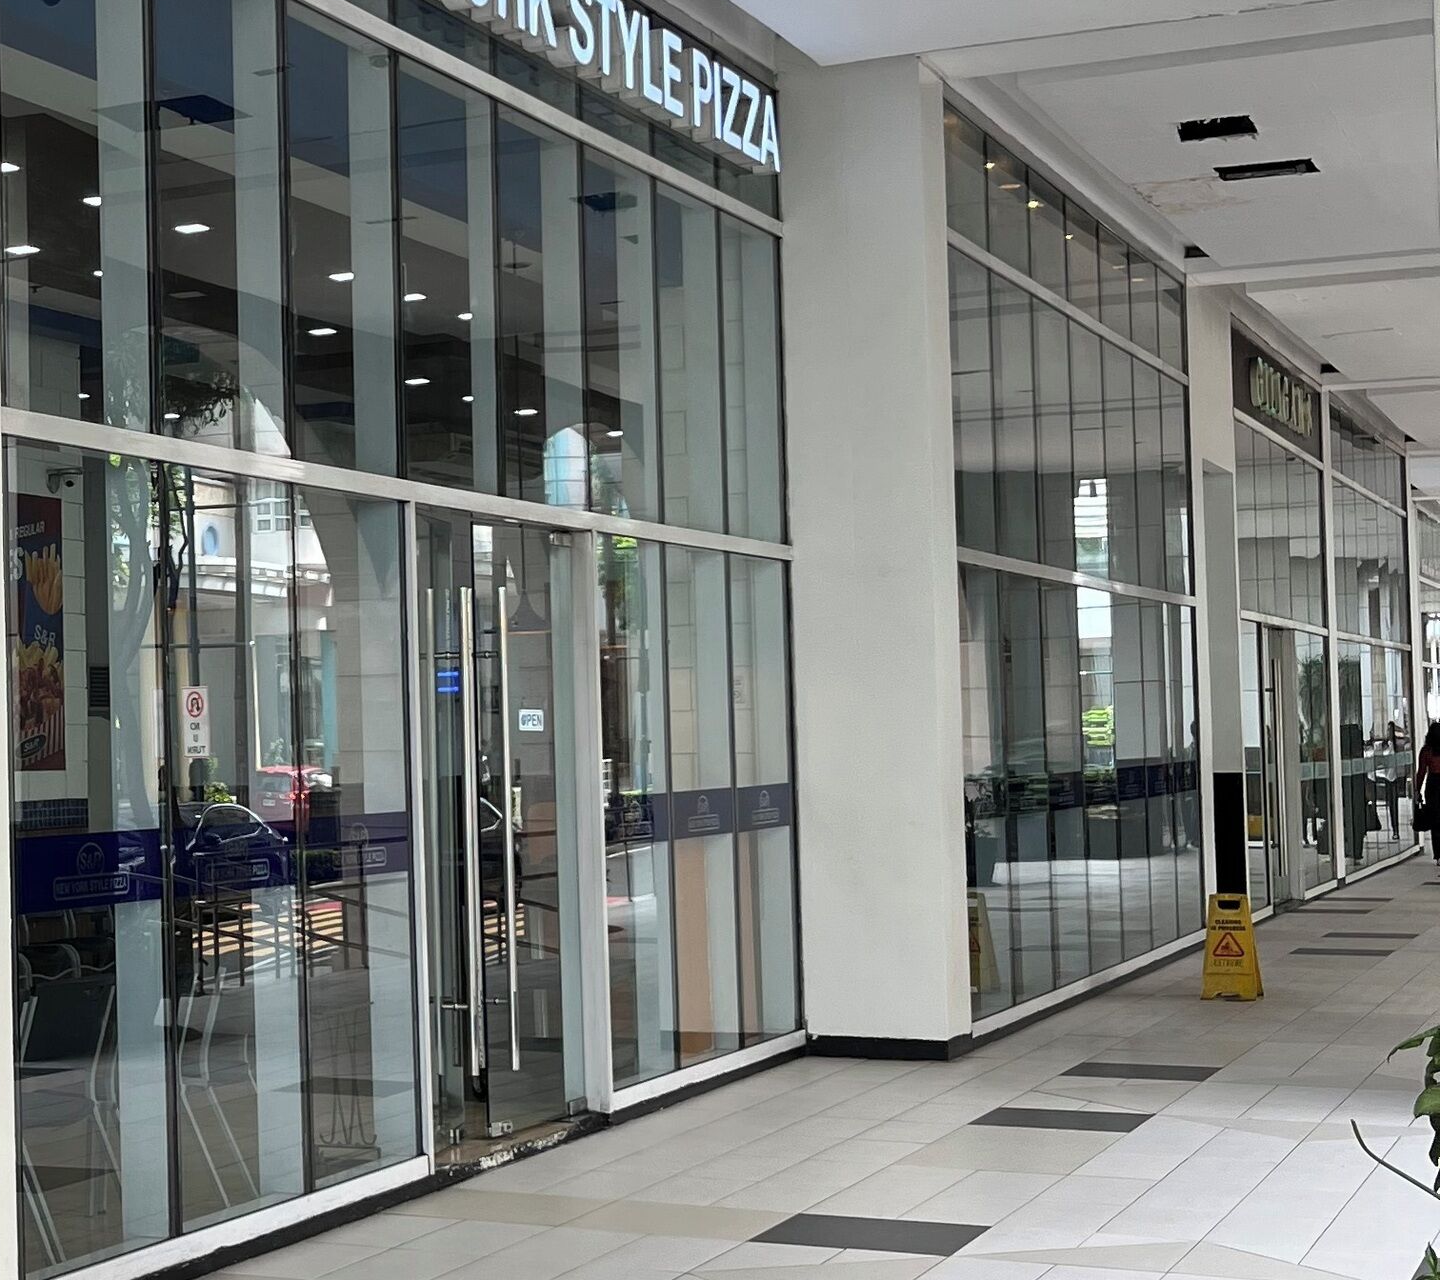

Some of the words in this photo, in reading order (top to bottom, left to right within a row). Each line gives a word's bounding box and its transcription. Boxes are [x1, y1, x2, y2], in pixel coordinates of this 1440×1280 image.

[692, 46, 781, 172] PIZZA
[33, 624, 56, 646] S&R
[520, 713, 543, 727] OPEN
